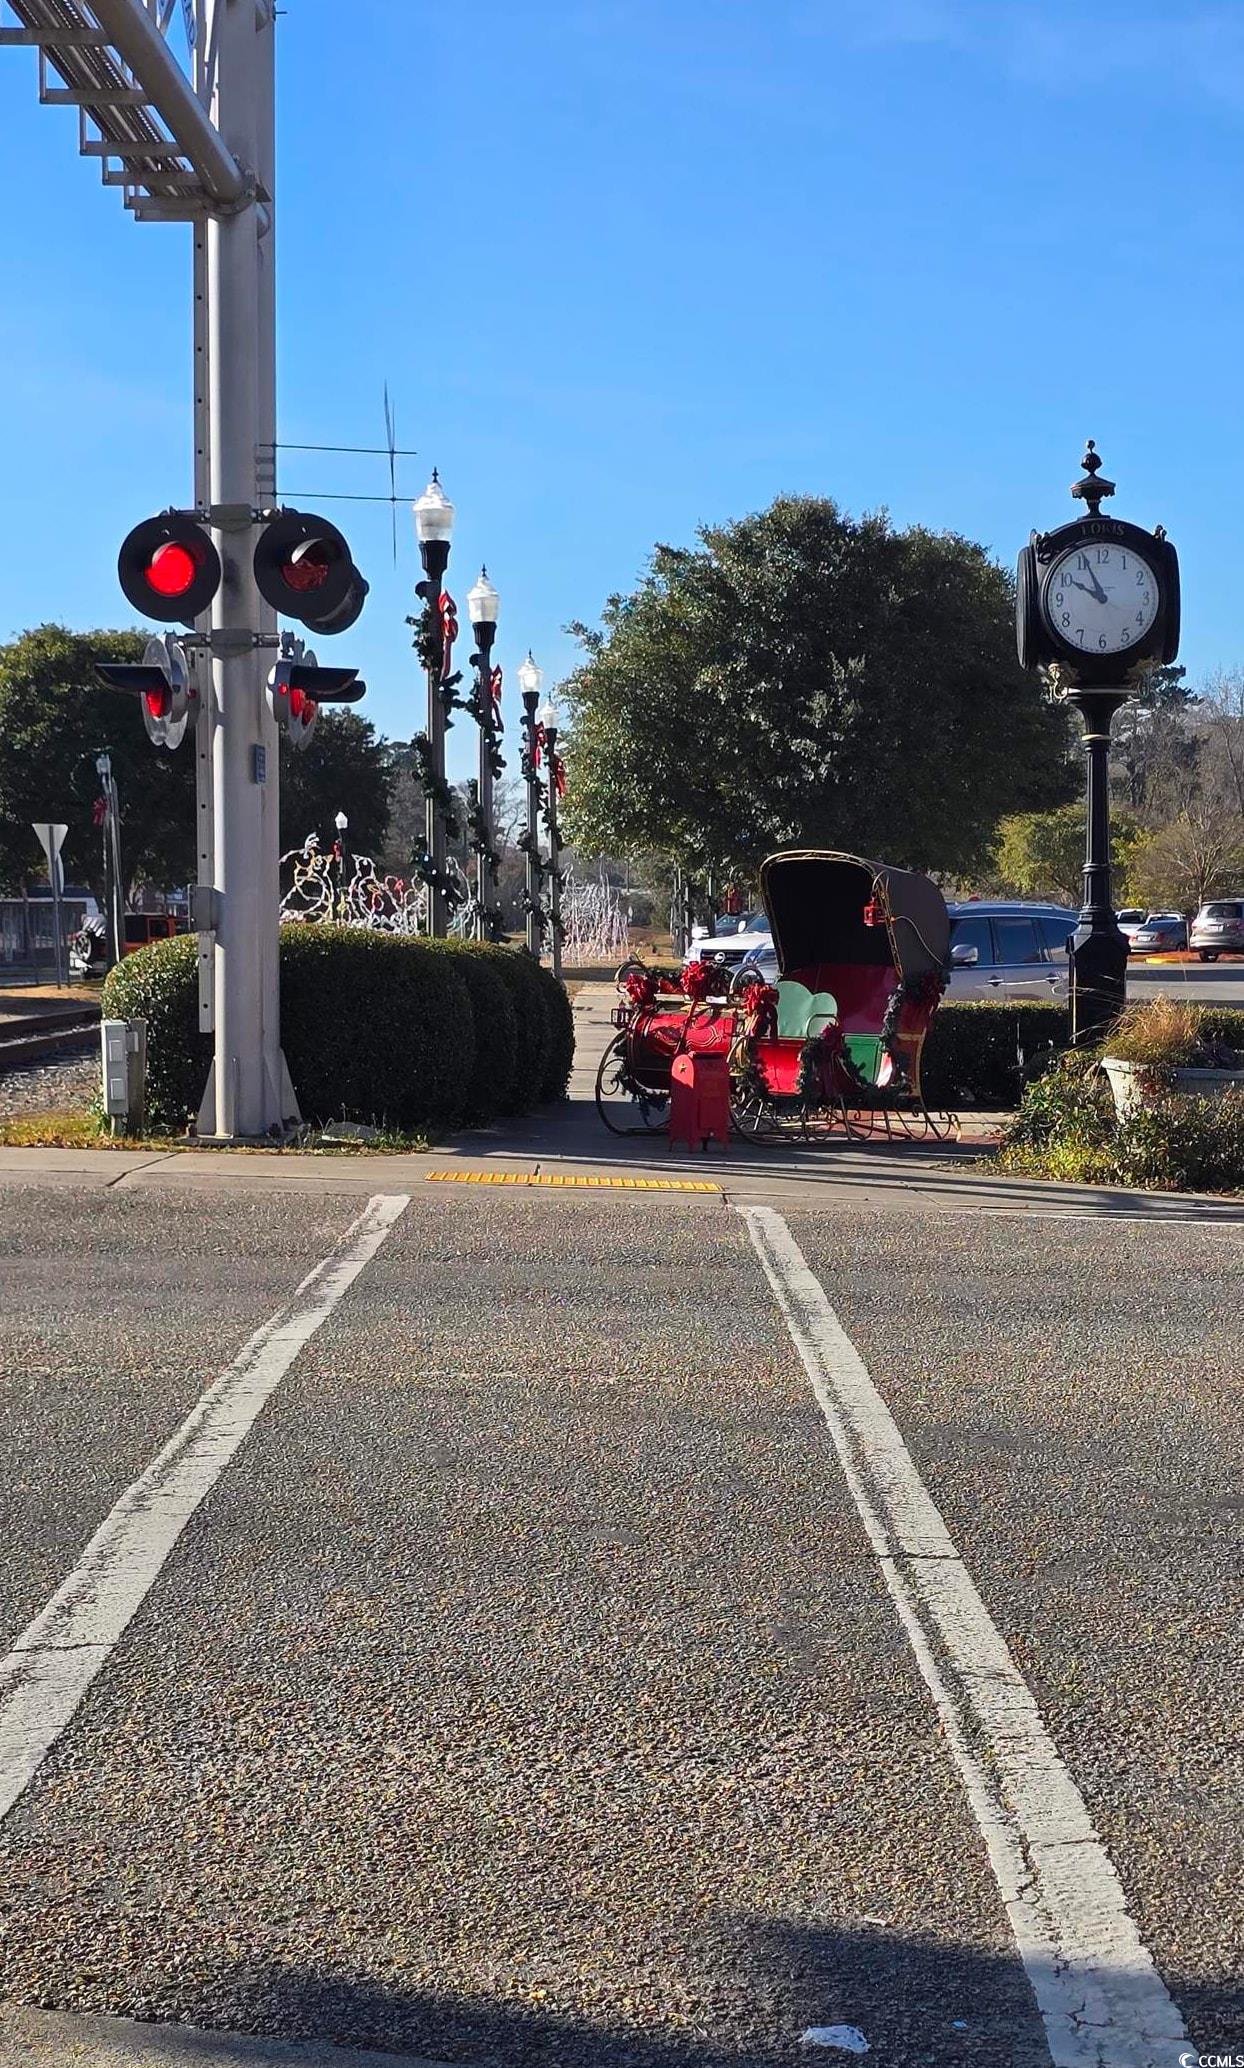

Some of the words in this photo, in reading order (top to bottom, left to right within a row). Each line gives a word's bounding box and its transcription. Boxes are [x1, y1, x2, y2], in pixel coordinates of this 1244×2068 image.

[1077, 555, 1087, 571] 11
[1096, 549, 1109, 564] 12
[1121, 555, 1127, 570] 1
[1060, 572, 1073, 588] 10
[1136, 570, 1144, 586] 2
[1056, 592, 1064, 608] 9
[1142, 591, 1150, 606] 3
[1061, 612, 1070, 628] 8
[1135, 610, 1144, 626] 4
[1075, 629, 1085, 644] 7
[1099, 633, 1107, 649] 6
[1120, 628, 1130, 643] 5
